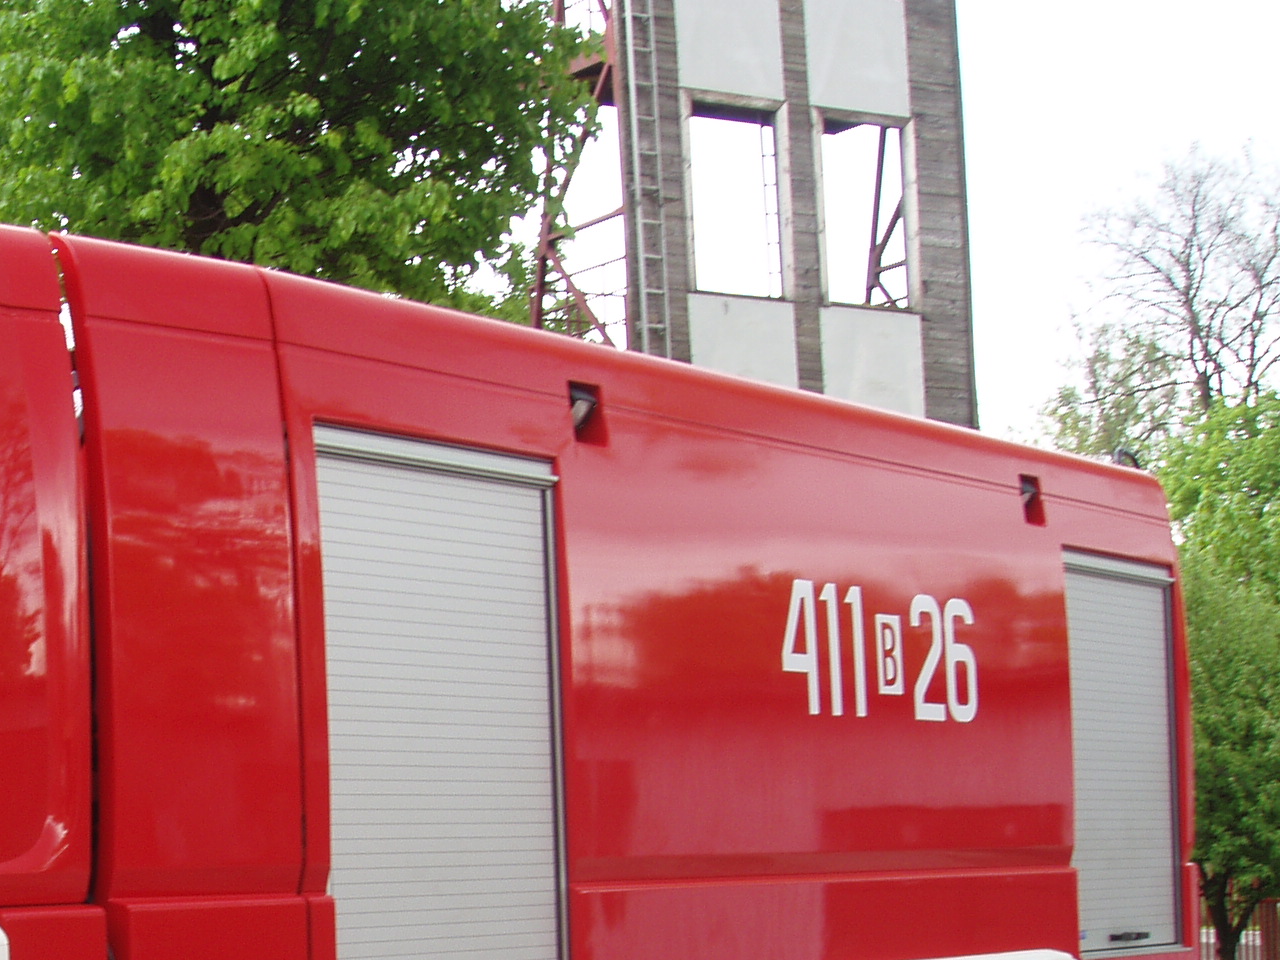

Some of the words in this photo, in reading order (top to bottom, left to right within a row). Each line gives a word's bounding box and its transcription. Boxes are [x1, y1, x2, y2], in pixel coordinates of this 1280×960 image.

[781, 578, 868, 718] 411
[878, 618, 901, 691] B
[909, 593, 978, 723] 26
